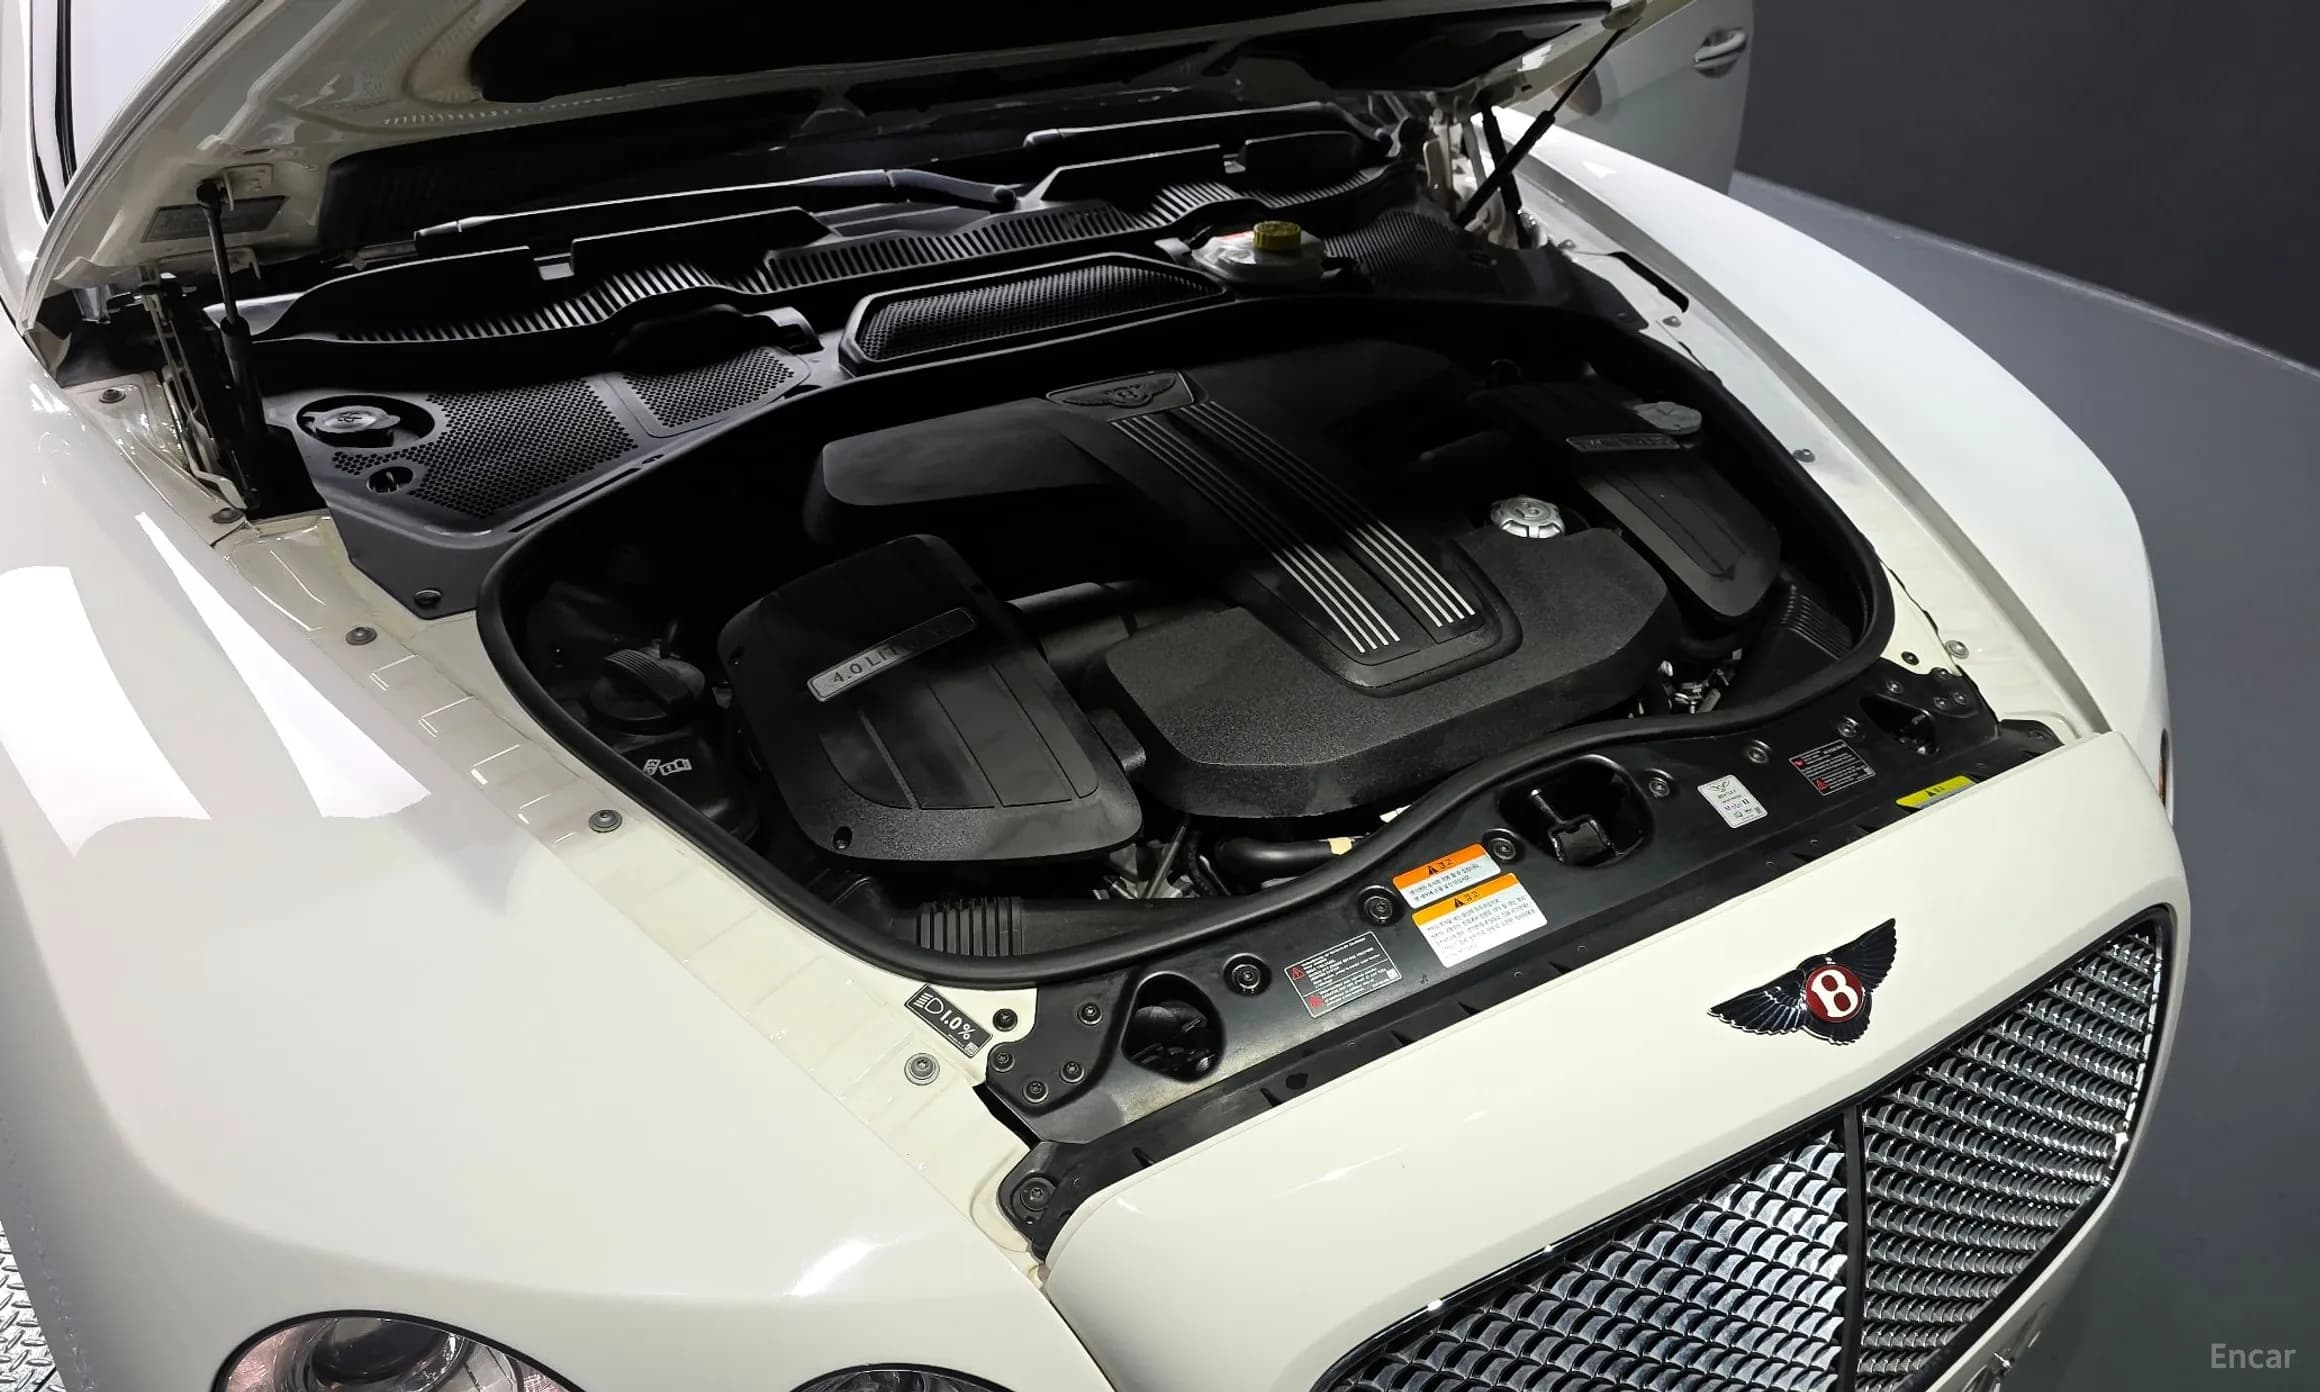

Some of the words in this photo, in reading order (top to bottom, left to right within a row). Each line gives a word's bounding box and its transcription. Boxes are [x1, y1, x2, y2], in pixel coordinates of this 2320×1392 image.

[832, 663, 863, 683] 4.0
[1811, 969, 1859, 1018] B
[940, 1010, 977, 1040] 1.0%
